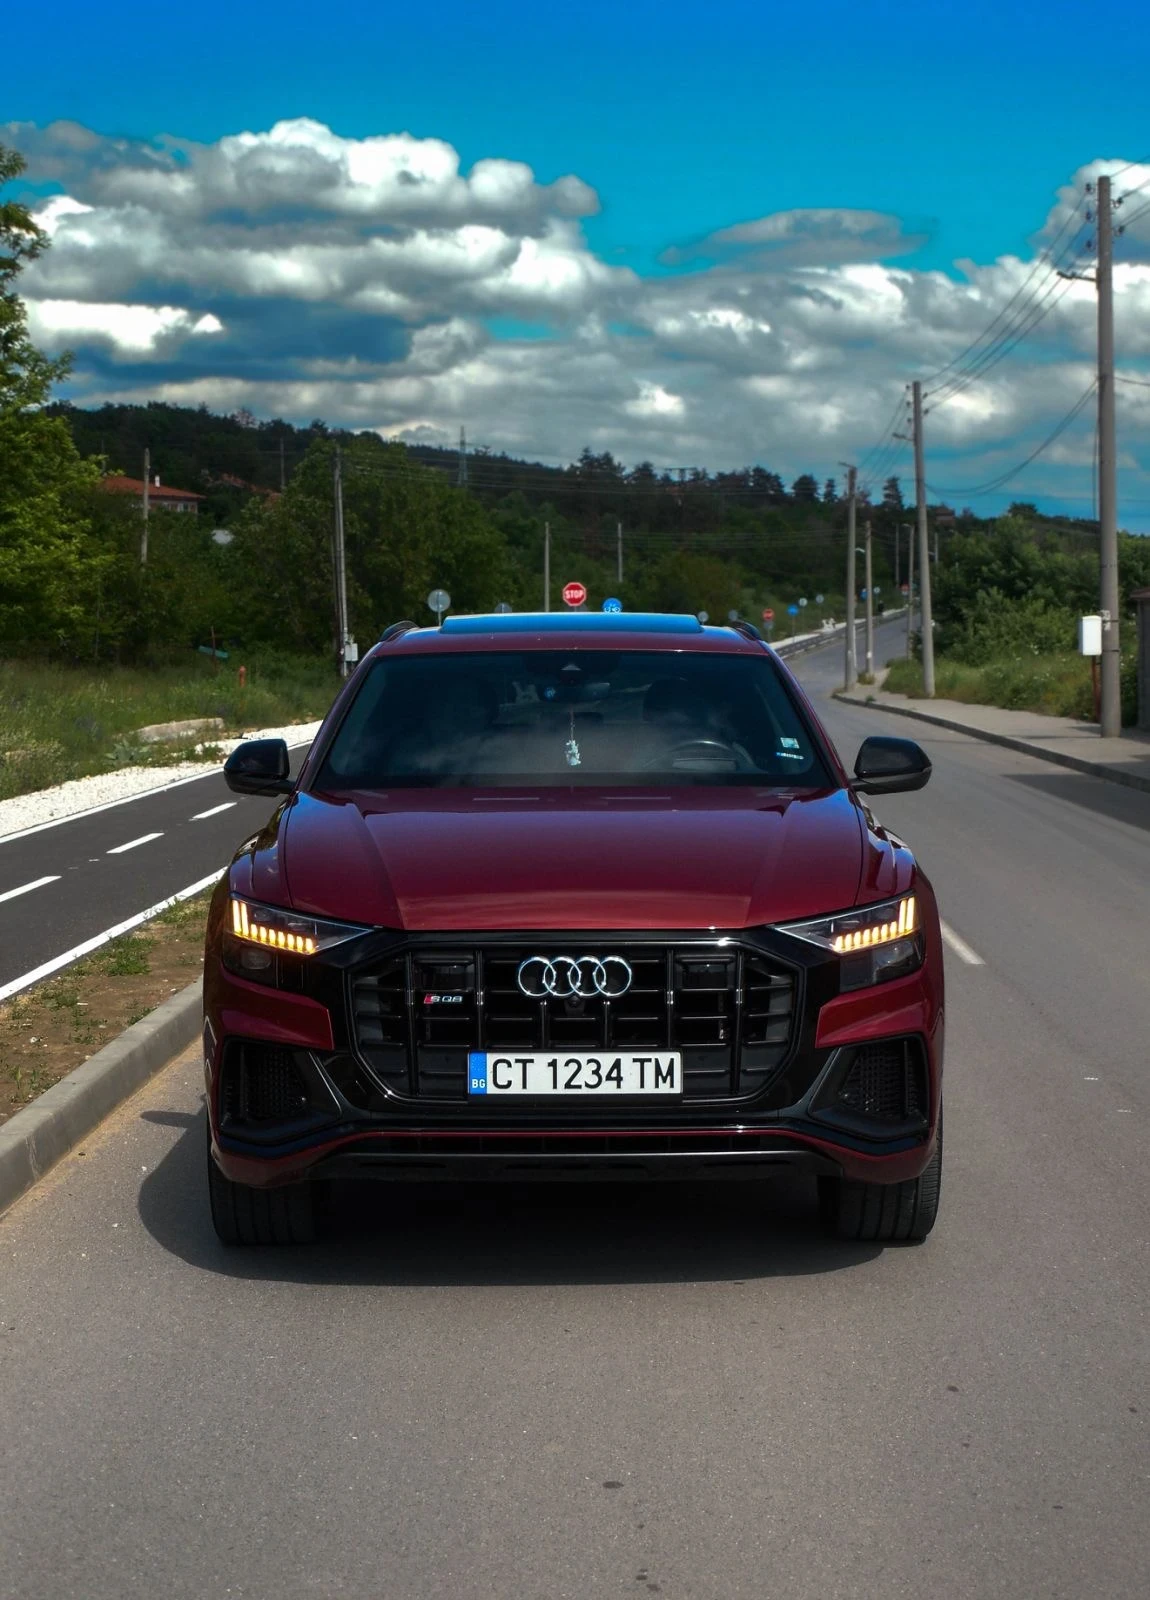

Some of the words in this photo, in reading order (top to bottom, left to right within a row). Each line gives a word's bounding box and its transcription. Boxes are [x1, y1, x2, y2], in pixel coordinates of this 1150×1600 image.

[565, 589, 584, 599] STOP
[492, 1058, 534, 1089] CT
[547, 1058, 623, 1089] 1234
[632, 1058, 675, 1089] TM
[471, 1079, 486, 1088] BG
